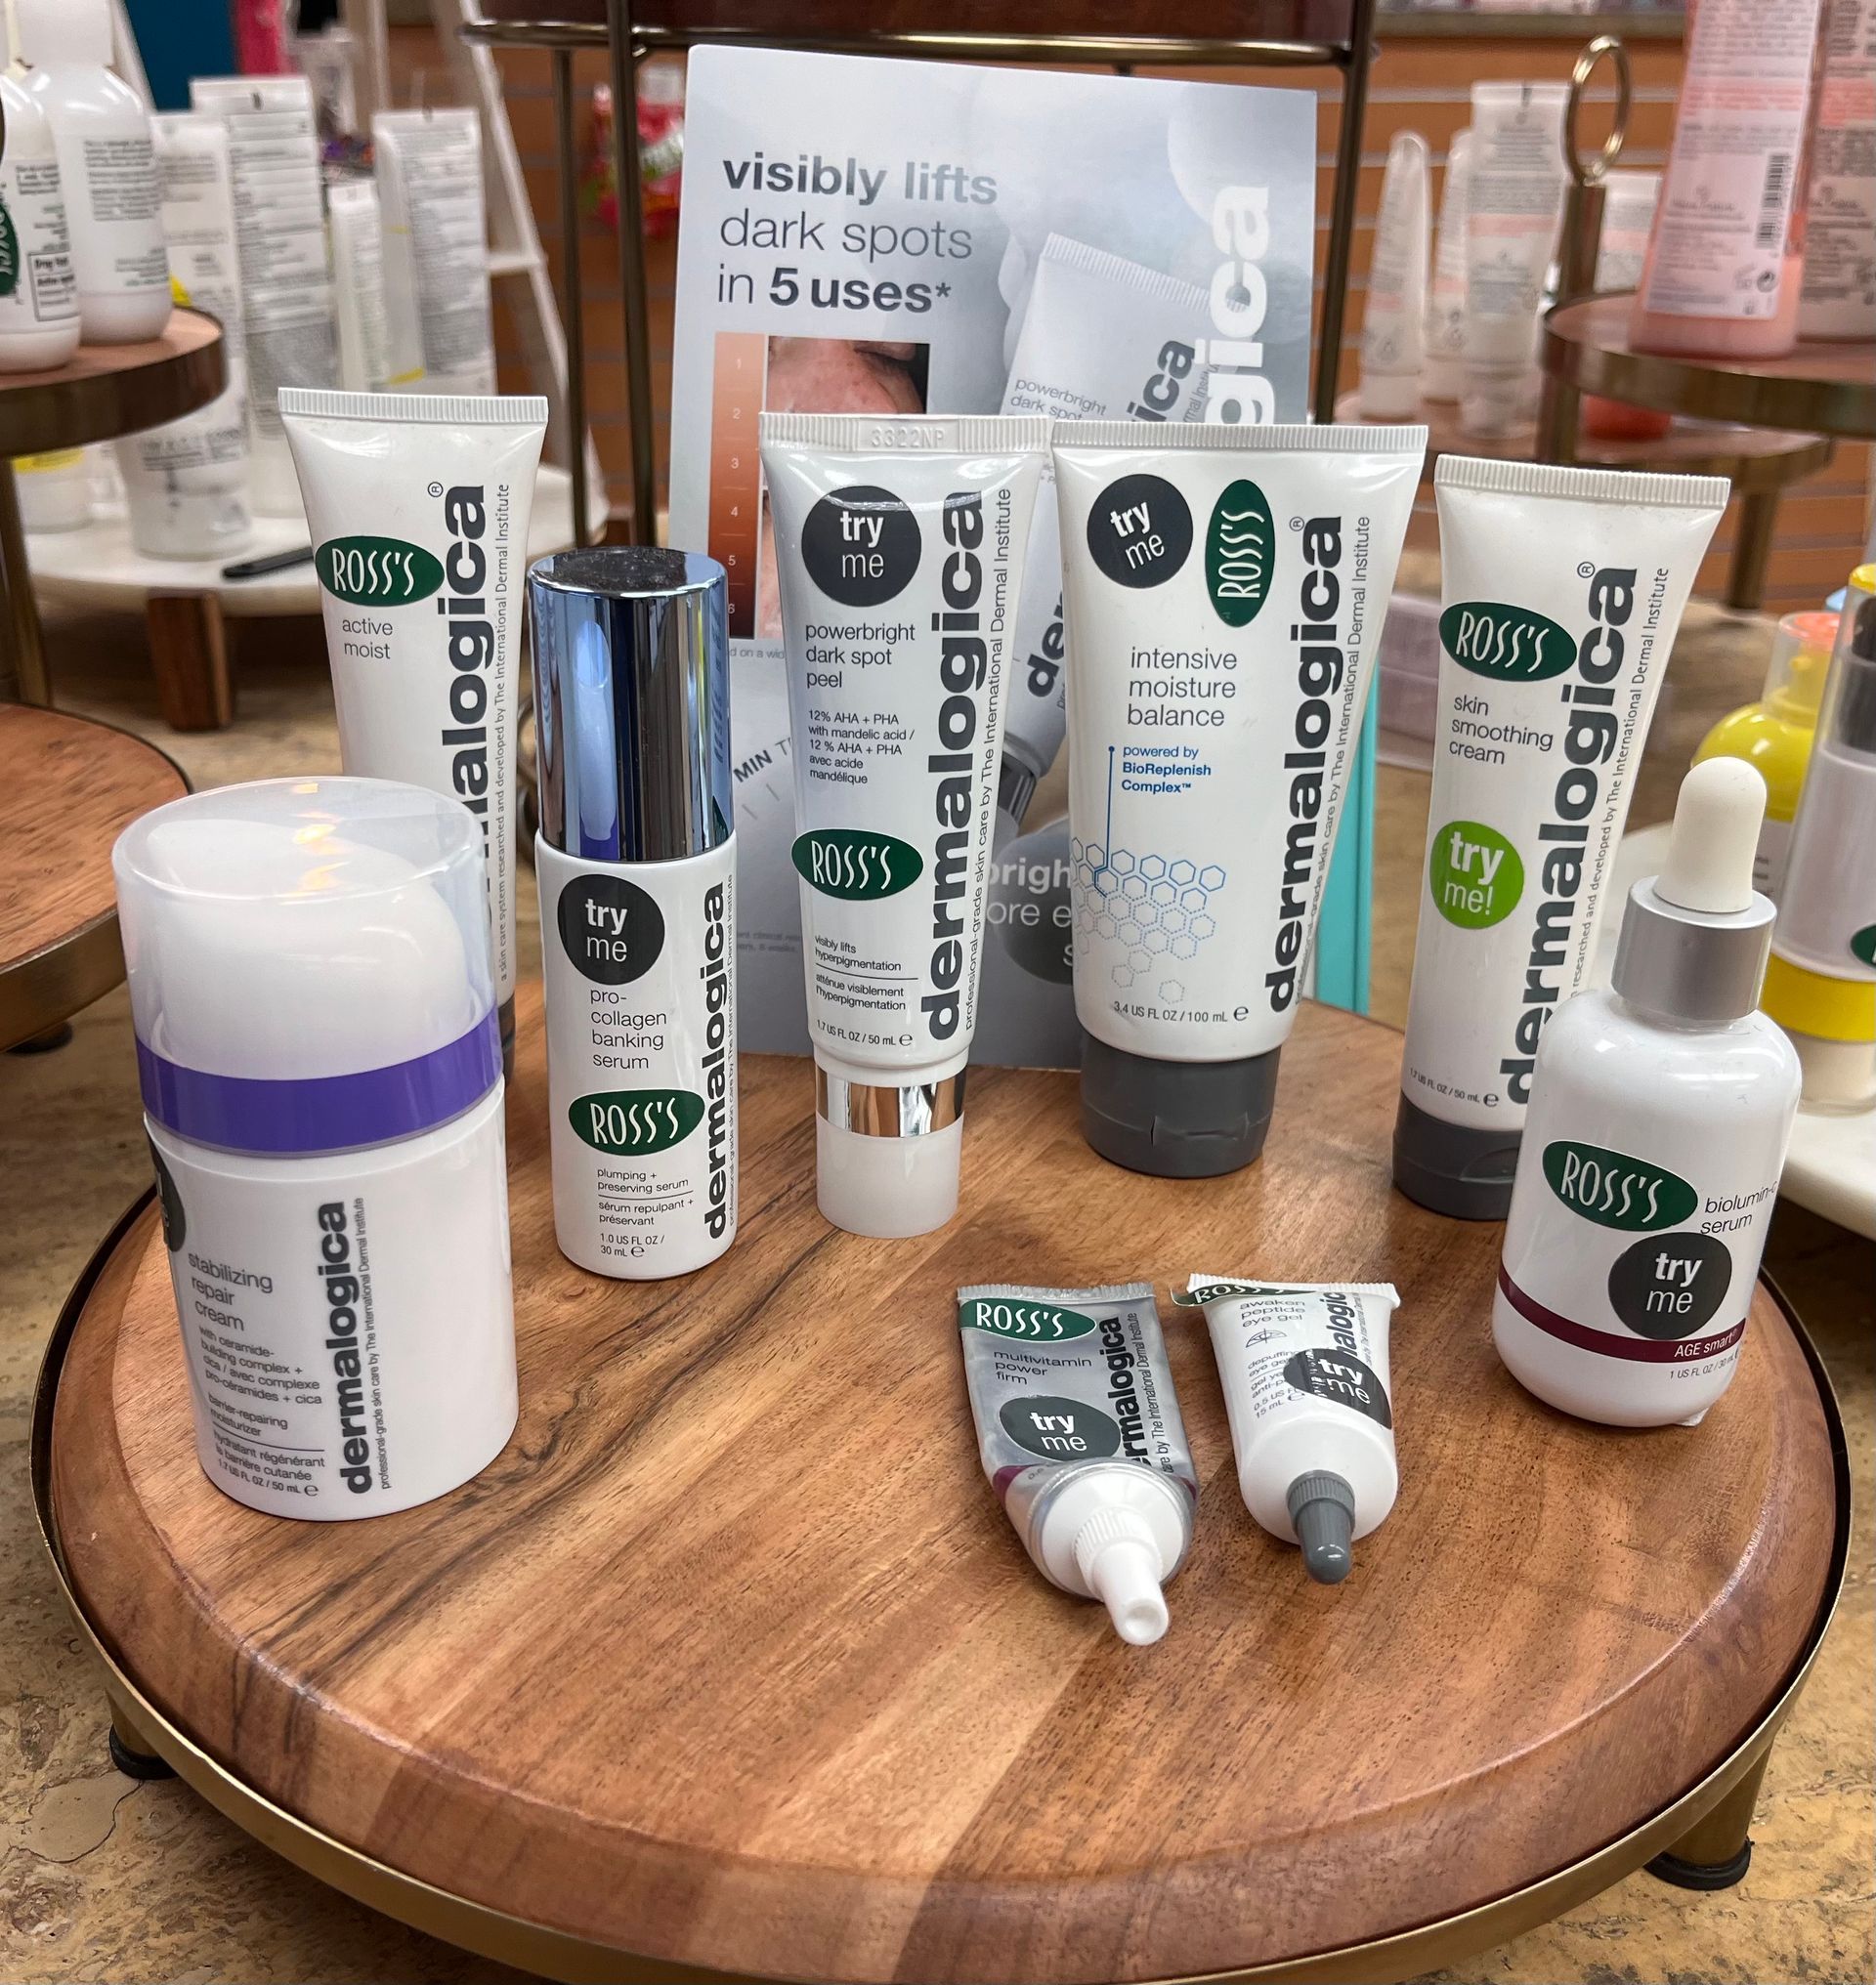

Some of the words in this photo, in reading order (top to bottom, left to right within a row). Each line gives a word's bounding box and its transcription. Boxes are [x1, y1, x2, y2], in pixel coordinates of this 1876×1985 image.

[723, 151, 886, 205] visibly
[901, 161, 997, 205] lifts
[720, 208, 824, 250] dark
[842, 221, 972, 263] spots
[718, 263, 752, 304] in
[769, 267, 798, 307] 5
[736, 358, 743, 369] 1
[1010, 395, 1045, 413] dark
[1014, 378, 1107, 417] powerbright
[732, 407, 742, 420] 2
[730, 456, 740, 470] 3
[495, 484, 509, 541] Institute
[729, 505, 740, 519] 4
[1110, 501, 1151, 538] try
[840, 510, 883, 548] try
[994, 488, 1010, 562] Institute
[727, 553, 738, 568] 5
[1125, 534, 1165, 570] me
[1217, 510, 1264, 598] ROSS'S
[1352, 517, 1370, 581] Institute
[332, 548, 414, 596] ROSS'S
[495, 547, 508, 592] Dermal
[842, 553, 884, 578] me
[991, 569, 1007, 632] Dermal
[1642, 568, 1669, 629] Institute
[342, 618, 393, 636] active
[1347, 587, 1365, 646] Dermal
[496, 595, 509, 676] International
[806, 623, 916, 645] powerbright
[1455, 611, 1549, 673] ROSS'S
[344, 643, 391, 659] moist
[806, 646, 845, 664] dark
[851, 649, 892, 668] spot
[1131, 647, 1237, 669] intensive
[1632, 631, 1654, 685] Dermal
[493, 677, 505, 705] The
[807, 671, 842, 688] peel
[984, 638, 1002, 744] International
[1130, 676, 1236, 697] moisture
[1337, 651, 1359, 746] International
[1454, 696, 1489, 716] skin
[809, 710, 831, 722] 12%
[834, 713, 859, 724] AHA
[874, 714, 899, 725] PHA
[1127, 703, 1224, 726] balance
[809, 726, 829, 738] with
[831, 727, 880, 739] mandelic
[883, 730, 907, 739] acid
[1452, 718, 1554, 751] smoothing
[1612, 688, 1642, 777] International
[494, 726, 506, 782] developed
[810, 739, 821, 750] 12
[837, 742, 862, 753] AHA
[876, 744, 902, 755] PHA
[1123, 745, 1178, 759] powered
[1183, 746, 1199, 760] by
[1449, 741, 1505, 765] cream
[733, 749, 773, 782] MIN
[809, 754, 831, 767] avec
[834, 757, 864, 769] acide
[921, 491, 987, 1040] dermalogica
[981, 748, 995, 782] The
[1123, 762, 1212, 779] BioReplenish
[1331, 750, 1344, 781] The
[810, 769, 868, 785] mandélique
[980, 784, 992, 808] by
[1606, 780, 1622, 804] The
[978, 810, 988, 846] care
[495, 816, 507, 877] researched
[1450, 831, 1504, 885] try
[1591, 825, 1610, 890] developed
[811, 840, 890, 890] ROSS'S
[1444, 880, 1494, 915] me!
[585, 898, 628, 936] try
[586, 936, 627, 962] me
[815, 935, 838, 951] visibly
[840, 942, 857, 953] lifts
[1572, 921, 1592, 988] researched
[815, 947, 901, 971] hyperpigmentation
[591, 990, 627, 1004] pro-
[816, 973, 845, 991] atténue
[847, 985, 904, 997] visiblement
[591, 1011, 666, 1031] collagen
[1114, 1000, 1129, 1014] 3.4
[1131, 1004, 1145, 1016] US
[1147, 1006, 1160, 1019] FL
[1163, 1009, 1177, 1021] OZ
[1188, 1011, 1209, 1023] 100
[1213, 1010, 1228, 1023] mL
[592, 1030, 664, 1050] banking
[593, 1054, 649, 1069] serum
[700, 881, 727, 1239] dermalogica
[590, 1097, 679, 1145] ROSS'S
[597, 1168, 647, 1182] plumping
[597, 1181, 653, 1194] preserving
[656, 1179, 689, 1191] serum
[1560, 1151, 1663, 1223] ROSS'S
[354, 1197, 366, 1237] Institute
[598, 1201, 631, 1212] sérum
[634, 1200, 685, 1214] repulpant
[599, 1214, 655, 1226] préservant
[1700, 1213, 1752, 1235] serum
[600, 1233, 614, 1244] 1.0
[616, 1236, 629, 1245] US
[631, 1237, 642, 1246] FL
[645, 1236, 659, 1246] OZ
[600, 1245, 613, 1254] 30
[615, 1247, 627, 1257] mL
[356, 1238, 370, 1273] Dermal
[189, 1253, 274, 1293] stabilizing
[1654, 1252, 1703, 1288] try
[192, 1277, 234, 1305] repair
[360, 1273, 375, 1332] International
[1645, 1289, 1693, 1314] me
[195, 1300, 244, 1331] cream
[1240, 1299, 1306, 1310] awaken
[1241, 1306, 1306, 1320] peptide
[977, 1302, 1063, 1336] ROSS'S
[1243, 1316, 1272, 1328] eye
[219, 1336, 275, 1358] ceramide-
[318, 1202, 372, 1494] dermalogica
[365, 1332, 376, 1352] The
[1674, 1342, 1701, 1358] AGE
[200, 1339, 236, 1366] building
[239, 1358, 290, 1374] complex
[994, 1351, 1092, 1367] multivitamin
[1132, 1341, 1150, 1369] Dermal
[230, 1368, 255, 1382] avec
[258, 1376, 320, 1391] complexe
[995, 1362, 1047, 1375] power
[996, 1372, 1027, 1384] firm
[1318, 1359, 1362, 1384] try
[295, 1394, 322, 1404] cica
[1099, 1317, 1151, 1466] rmalogica
[1138, 1368, 1161, 1419] International
[208, 1393, 288, 1430] barrier-repairing
[211, 1409, 261, 1436] moisturizer
[1030, 1412, 1075, 1434] try
[1152, 1421, 1165, 1439] The
[1042, 1435, 1087, 1452] me
[260, 1451, 325, 1467] régénérant
[264, 1466, 312, 1481] cutanée
